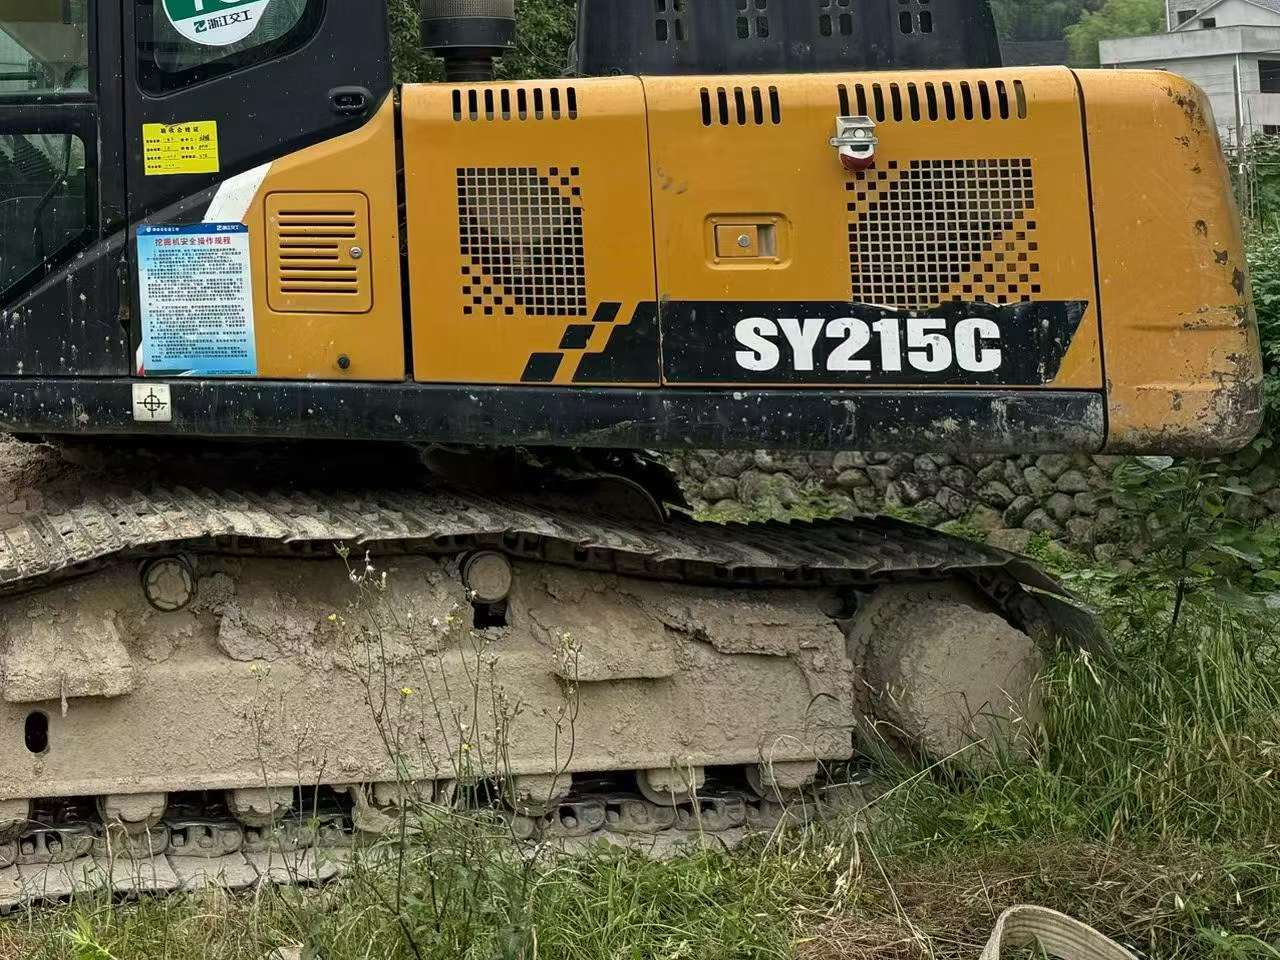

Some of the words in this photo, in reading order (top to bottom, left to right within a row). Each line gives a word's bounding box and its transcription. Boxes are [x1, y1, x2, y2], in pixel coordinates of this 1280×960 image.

[207, 10, 253, 30] 浙江交工
[155, 236, 231, 247] 挖掘机安全操作规程
[734, 317, 1002, 372] SY215C
